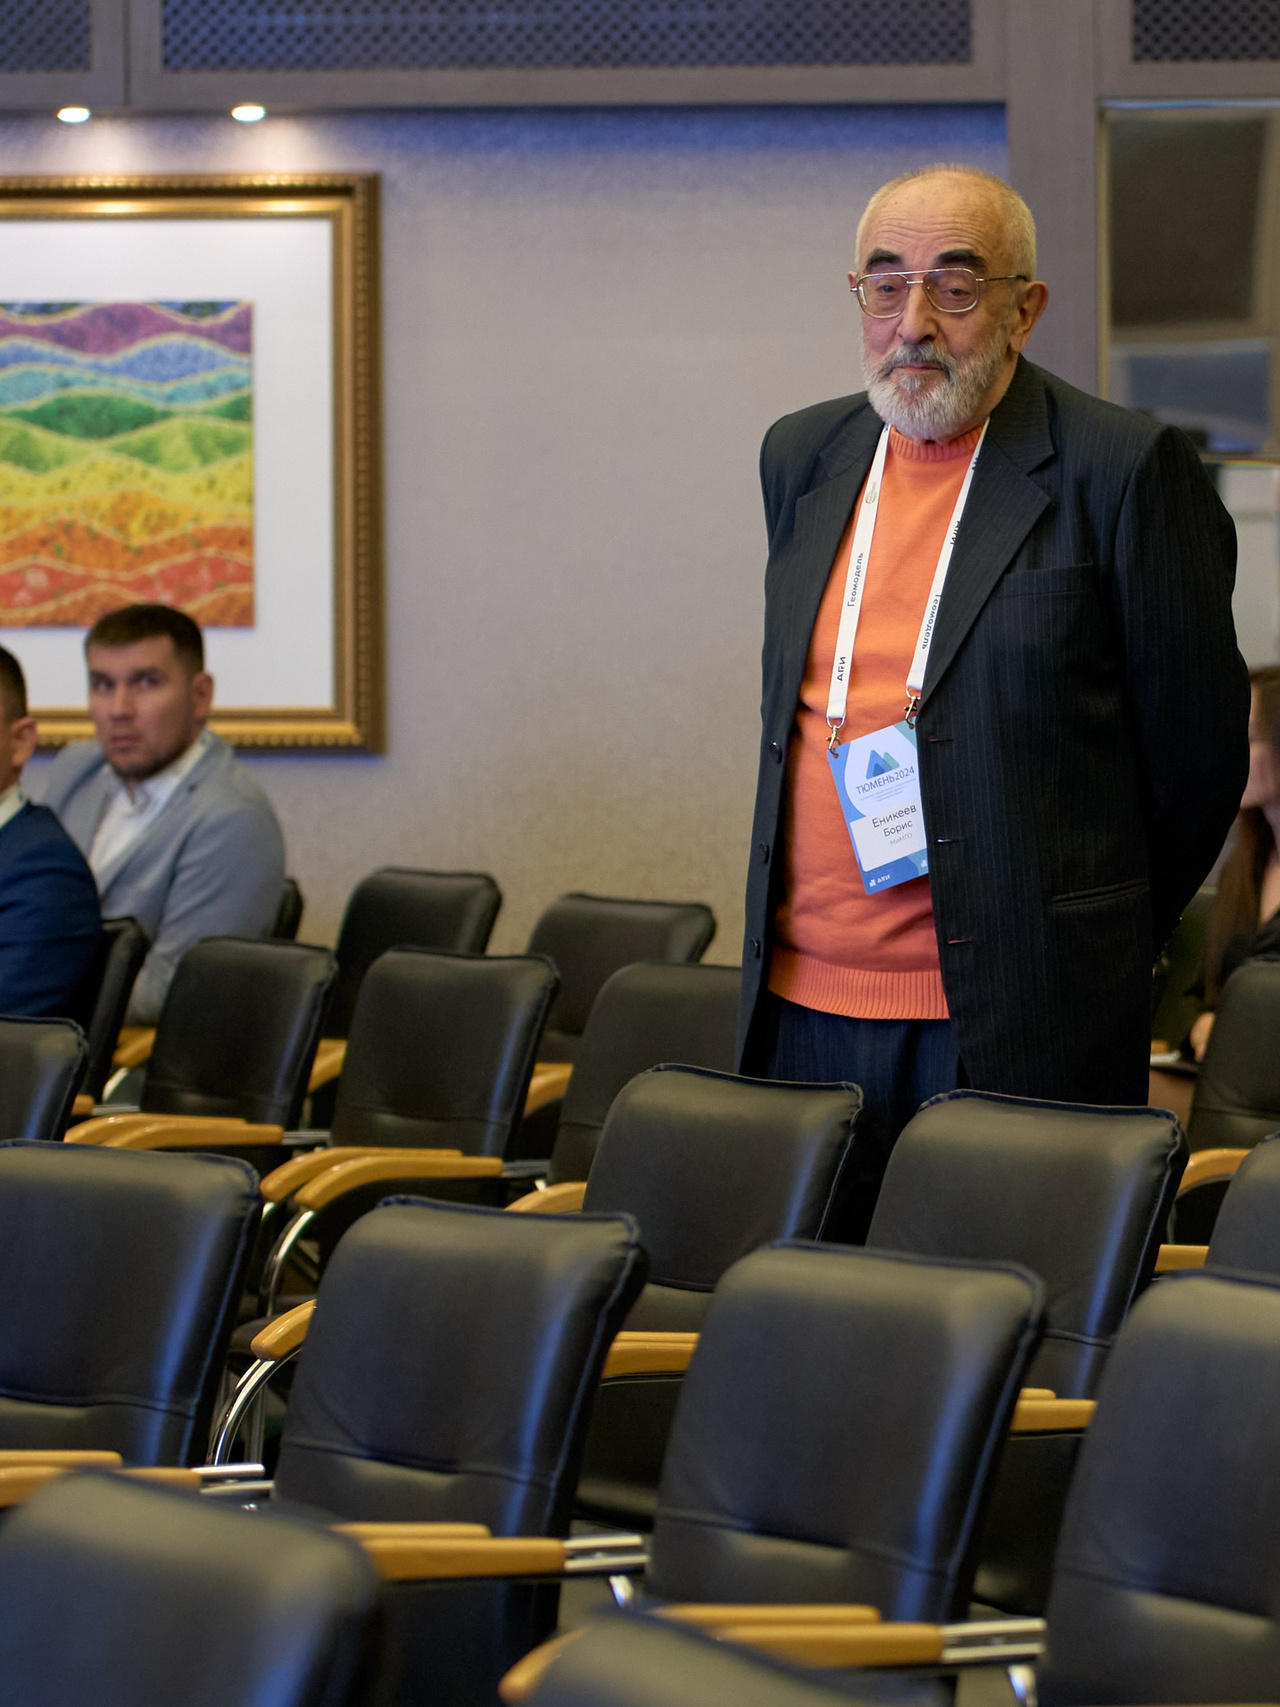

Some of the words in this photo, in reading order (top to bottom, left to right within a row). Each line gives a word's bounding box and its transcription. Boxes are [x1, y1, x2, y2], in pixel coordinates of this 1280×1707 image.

[847, 552, 864, 607] Геомодель
[855, 766, 915, 795] ТЮМЕНЬ2024
[872, 804, 917, 829] Еникеев
[883, 819, 914, 838] Борис
